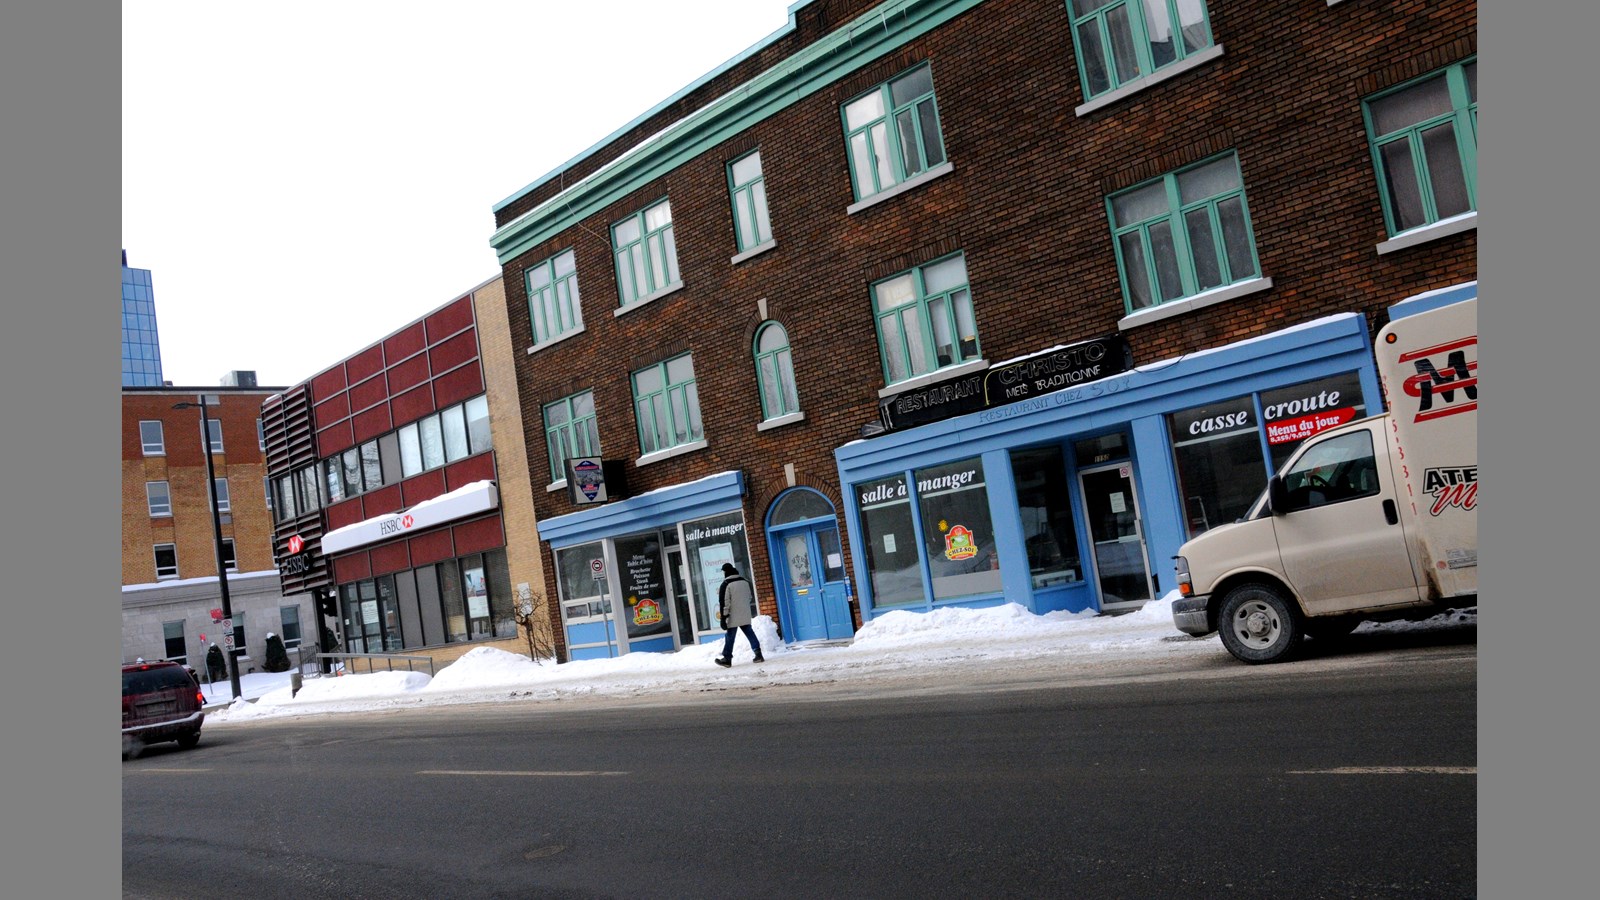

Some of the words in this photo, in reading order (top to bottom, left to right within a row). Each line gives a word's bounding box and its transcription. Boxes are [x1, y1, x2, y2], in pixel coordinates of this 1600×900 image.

[999, 343, 1106, 384] CHRISTO
[896, 376, 980, 414] RESTAURANT
[1189, 410, 1248, 435] casse
[1264, 390, 1340, 420] croute
[1268, 424, 1297, 438] Menu
[1299, 420, 1314, 431] du
[1315, 415, 1340, 431] jour
[861, 484, 894, 504] salle
[897, 480, 907, 497] à
[918, 469, 976, 492] manger
[380, 517, 401, 535] HSBC
[685, 528, 704, 542] salle
[705, 527, 711, 538] à
[711, 522, 744, 537] manger
[286, 553, 309, 575] HSBC
